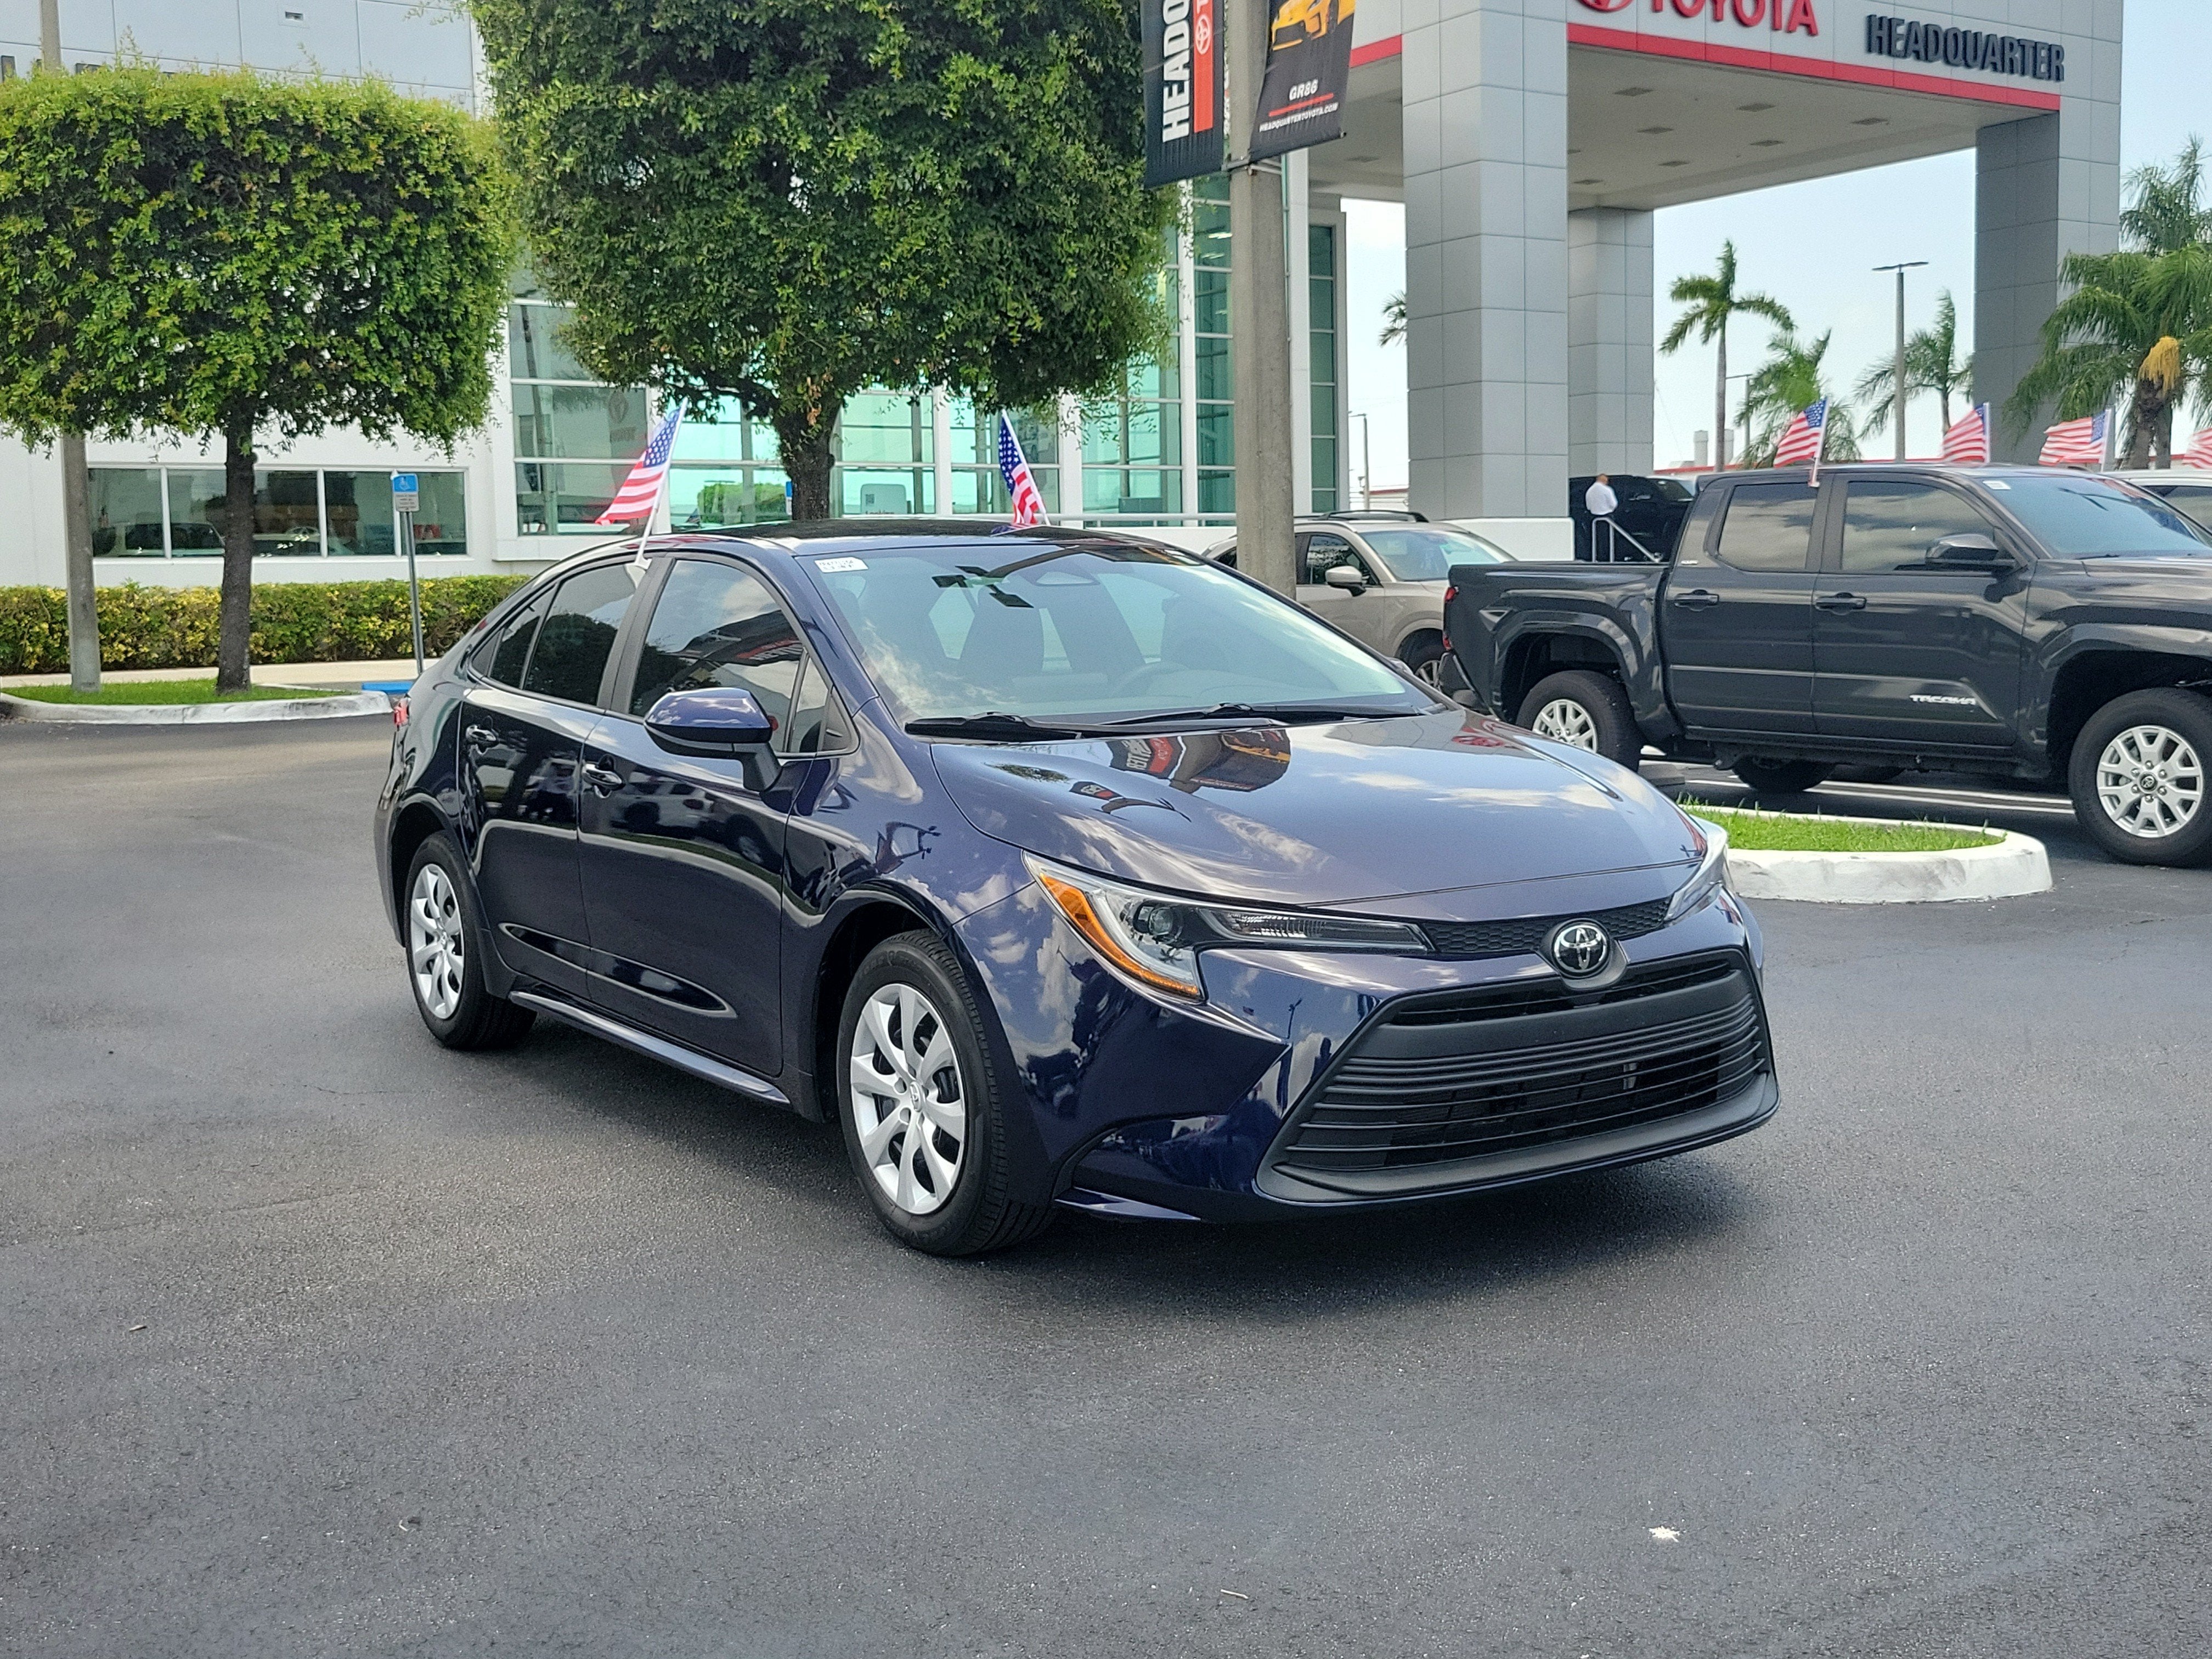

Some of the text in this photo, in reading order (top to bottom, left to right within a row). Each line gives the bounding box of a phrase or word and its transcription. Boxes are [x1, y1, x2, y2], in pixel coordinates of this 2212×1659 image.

[1652, 0, 1818, 36] OTA
[1865, 14, 2064, 82] HEADQUARTER
[1289, 79, 1319, 101] GR86
[1909, 695, 1976, 706] TACOMA
